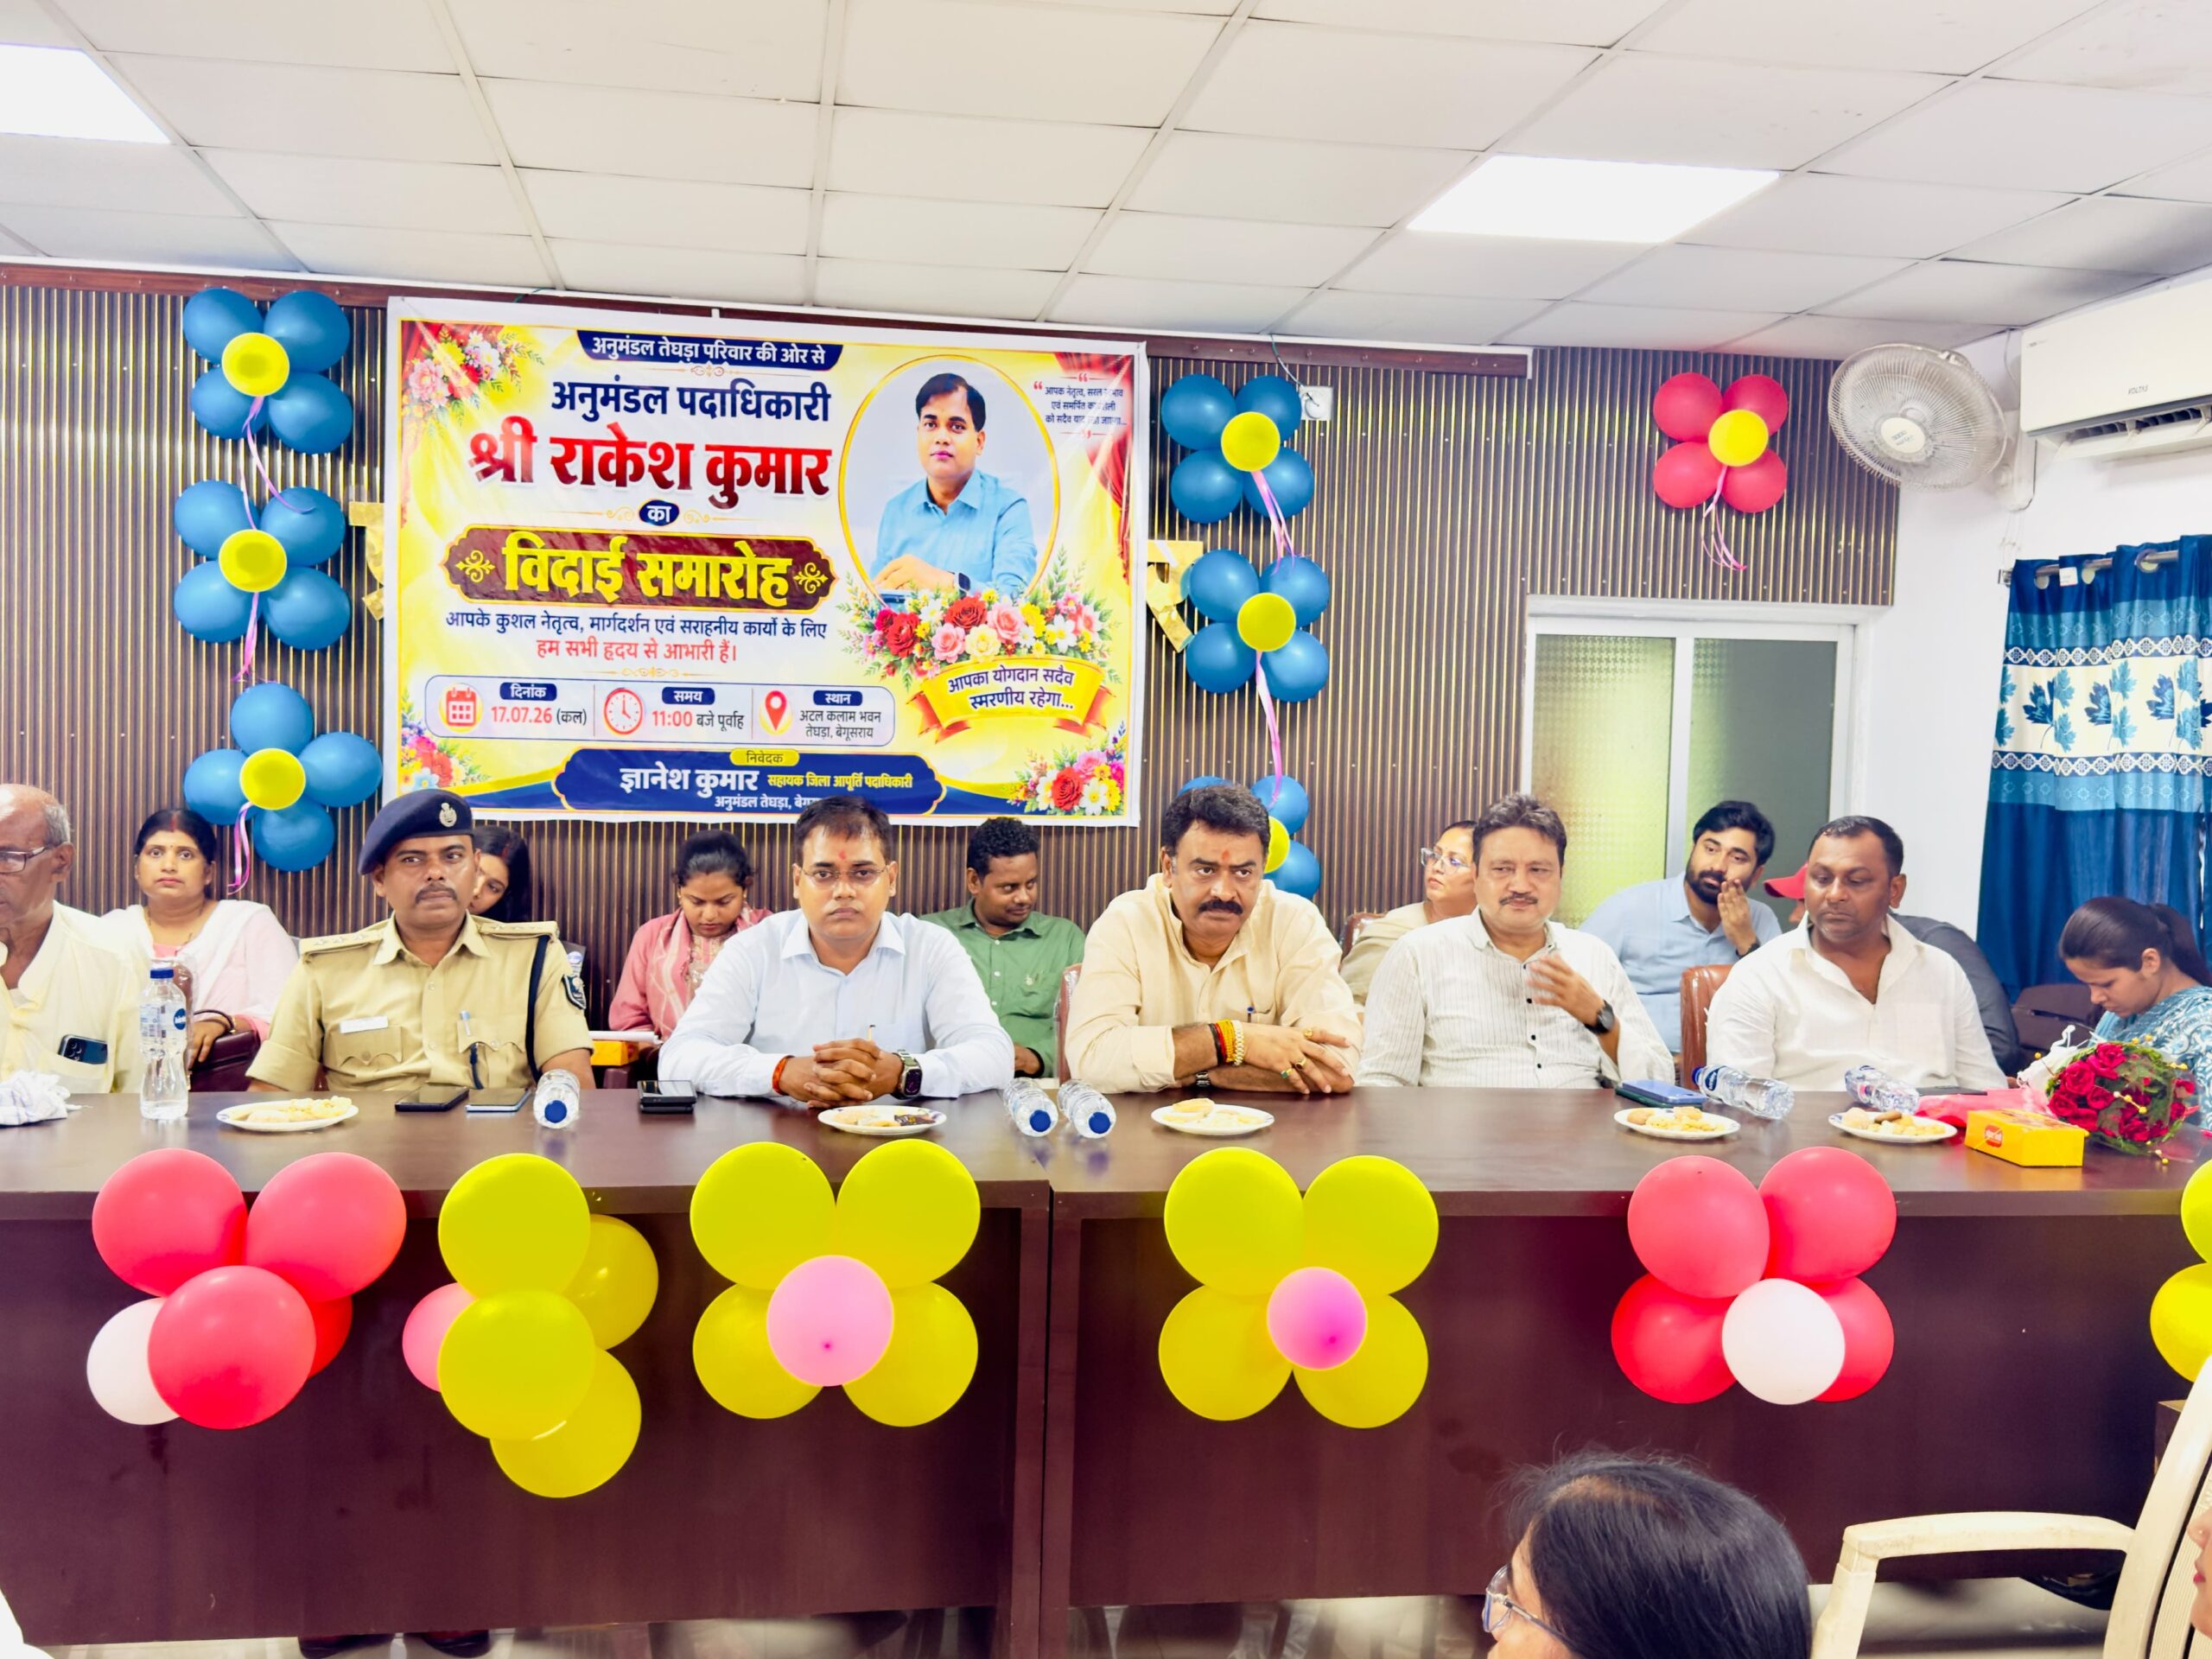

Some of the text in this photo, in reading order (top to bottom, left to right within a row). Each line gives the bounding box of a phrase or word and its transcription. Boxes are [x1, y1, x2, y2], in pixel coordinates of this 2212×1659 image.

[592, 334, 826, 364] अनुमंडल तेघड़ा परिवार की ओर से
[551, 374, 831, 423] अनुमंडल पदाधिकारी
[467, 415, 832, 510] श्री राकेश कुमार
[647, 505, 671, 523] का
[502, 531, 793, 606] विदाई समारोह
[446, 607, 491, 627] आपके
[496, 613, 537, 634] कुशल
[541, 610, 584, 635] नेतृत्व,
[589, 613, 650, 633] मार्गदर्शन
[655, 615, 675, 634] एवं
[680, 616, 739, 637] सराहनीय
[781, 618, 797, 637] के
[800, 618, 828, 639] लिए
[537, 639, 560, 658] हम
[565, 635, 599, 658] सभी
[603, 641, 639, 660] हृदय
[643, 638, 658, 659] से
[664, 639, 715, 661] आभारी
[948, 664, 1075, 693] आपका योगदान सदैव
[510, 683, 547, 698] दिनांक
[674, 690, 703, 702] समय
[824, 693, 851, 704] स्थान
[969, 687, 1074, 710] स्मरणीय रहेगा...
[491, 706, 588, 726] 17.07.26 (कल)
[652, 710, 693, 727] 11:00
[696, 710, 715, 728] बजे
[799, 710, 881, 722] अटल कलाम भवन
[836, 723, 874, 741] बेगूसराय
[747, 751, 784, 764] निवेदक
[619, 760, 913, 798] ज्ञानेश कुमार सहायक जिला आपूर्ति पदाधिकारी
[715, 792, 758, 810] अनुमंडल
